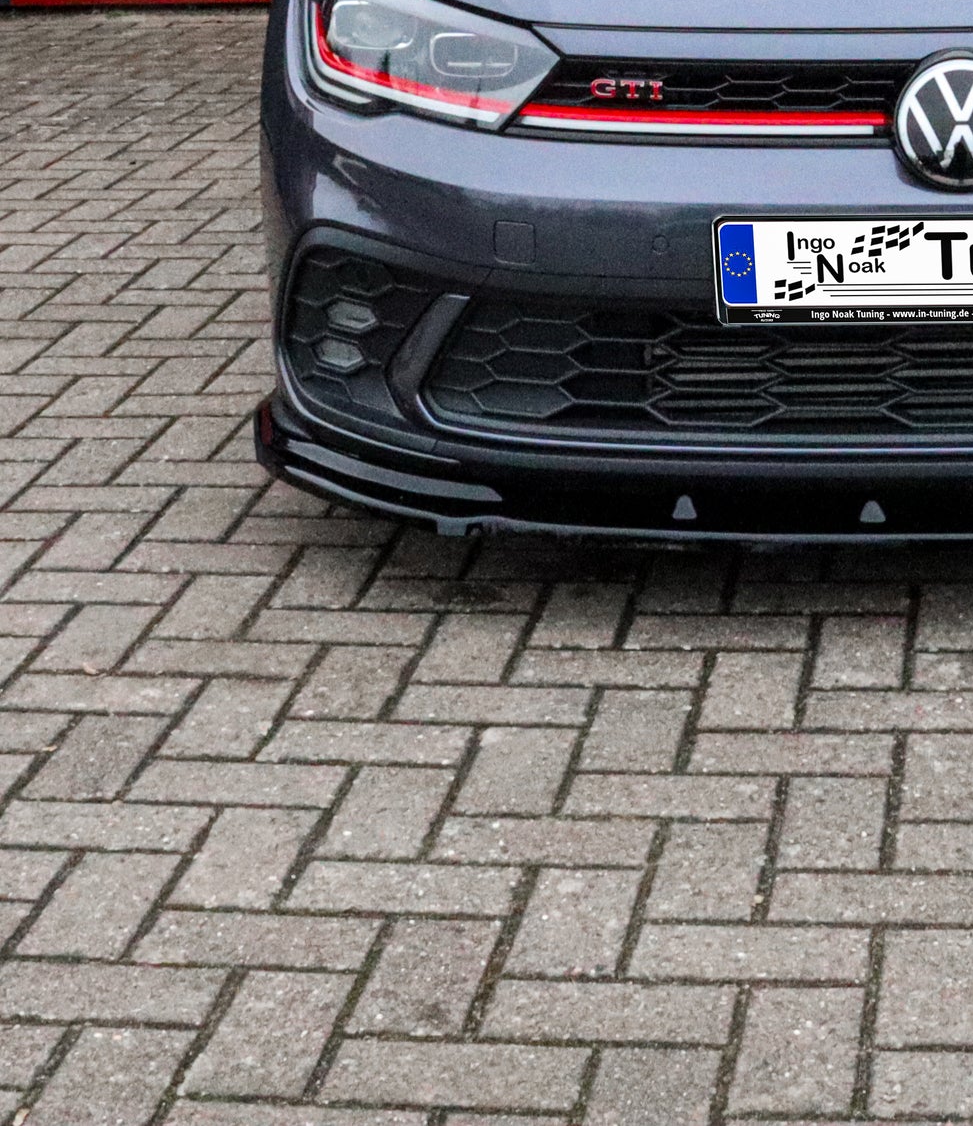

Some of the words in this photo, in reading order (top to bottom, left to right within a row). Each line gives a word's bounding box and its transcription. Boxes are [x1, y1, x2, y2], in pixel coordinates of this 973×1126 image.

[590, 78, 663, 100] GTI
[786, 231, 836, 261] Ingo
[816, 253, 887, 284] Noak
[811, 310, 830, 320] Ingo
[832, 310, 854, 318] Noak
[856, 309, 885, 320] Tuning
[892, 309, 969, 319] www.in-tuning.de
